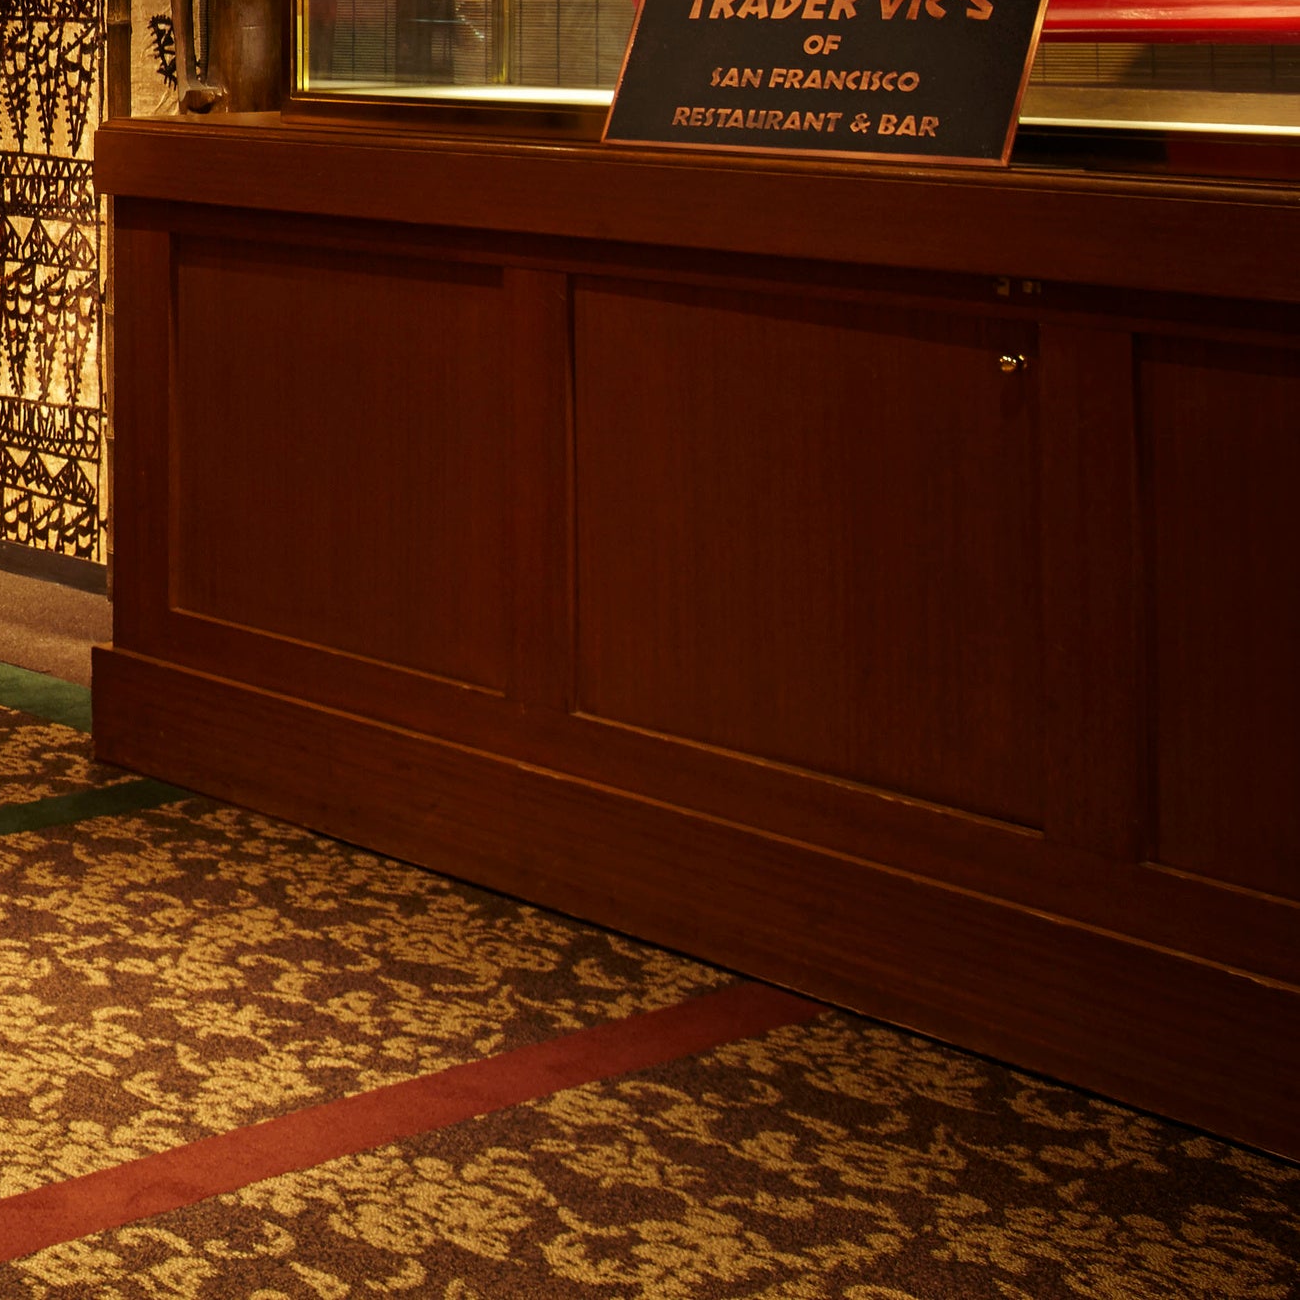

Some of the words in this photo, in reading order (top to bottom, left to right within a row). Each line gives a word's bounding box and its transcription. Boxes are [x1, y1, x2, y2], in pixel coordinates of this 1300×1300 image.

[802, 33, 842, 56] OF
[708, 66, 764, 90] SAN
[767, 67, 921, 93] FRANCISCO
[671, 106, 843, 134] RESTAURANT
[849, 111, 871, 134] &
[877, 113, 940, 139] BAR
